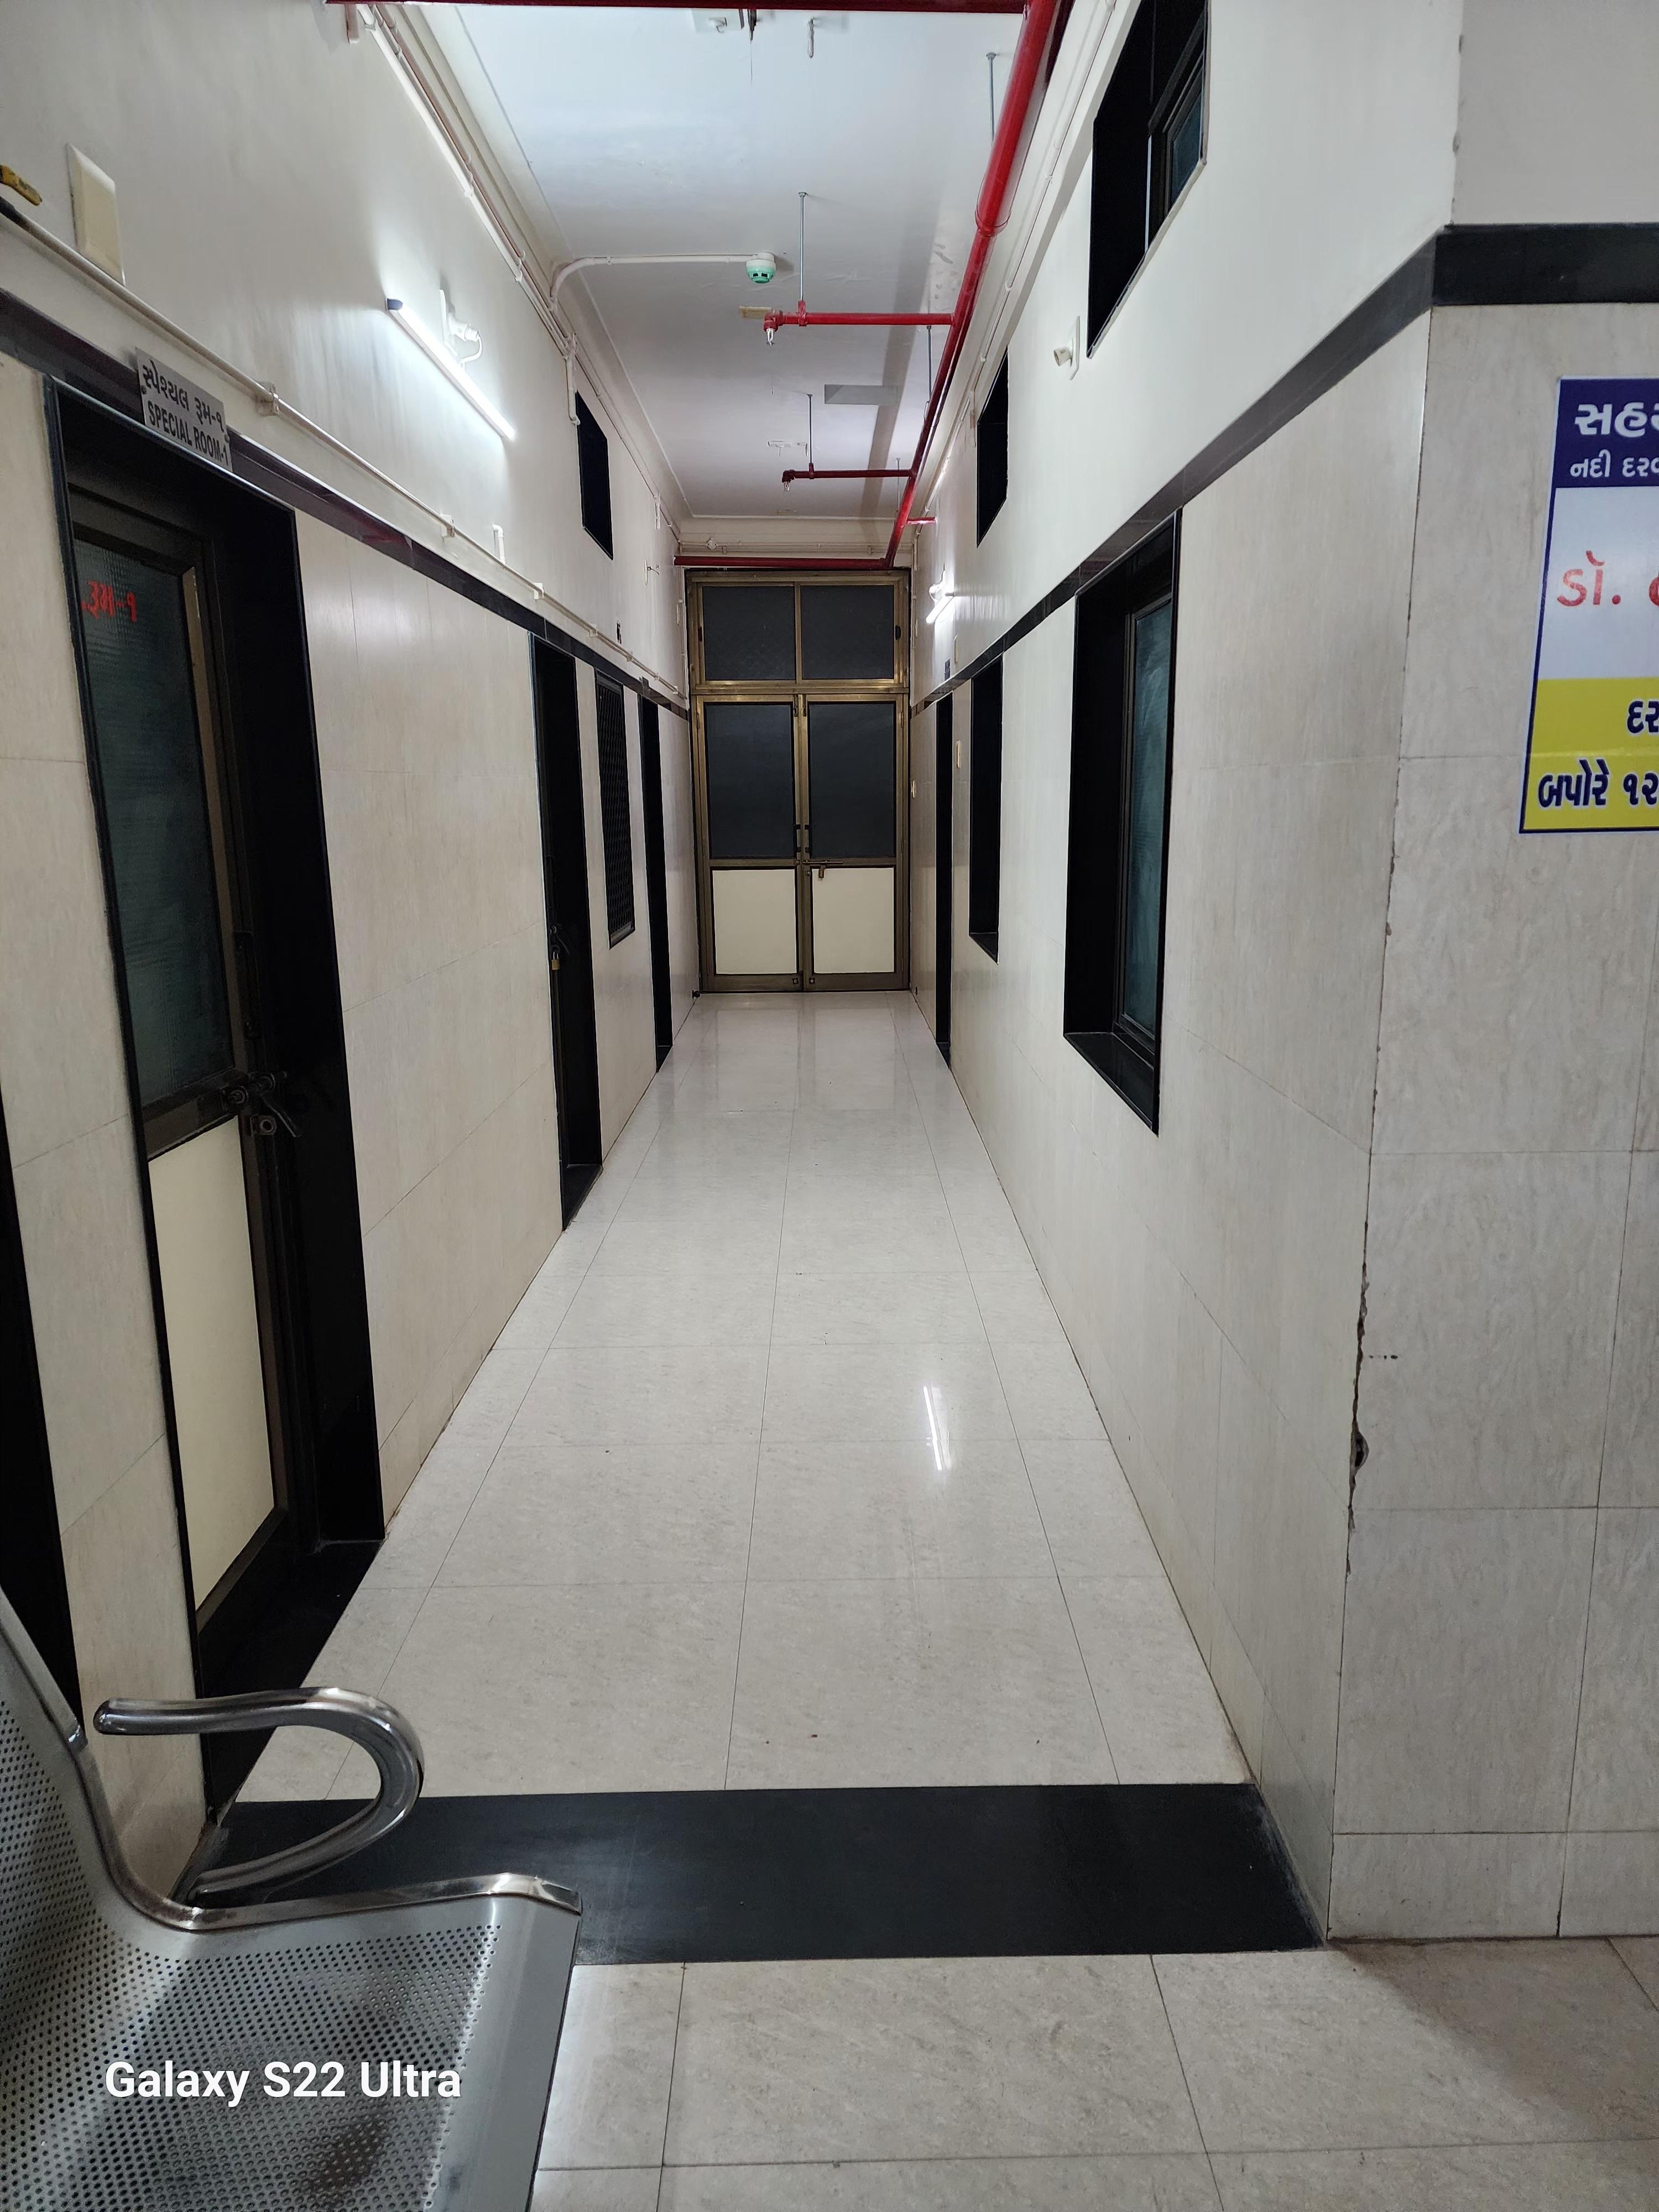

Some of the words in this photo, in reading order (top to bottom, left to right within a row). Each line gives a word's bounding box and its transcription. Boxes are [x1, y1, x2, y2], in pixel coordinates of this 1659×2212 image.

[148, 400, 192, 446] SPECIAL
[193, 426, 228, 466] ROOM-1
[1570, 449, 1611, 477] નદી
[1557, 550, 1621, 606] ડૉ.
[1538, 759, 1609, 807] બપોરે
